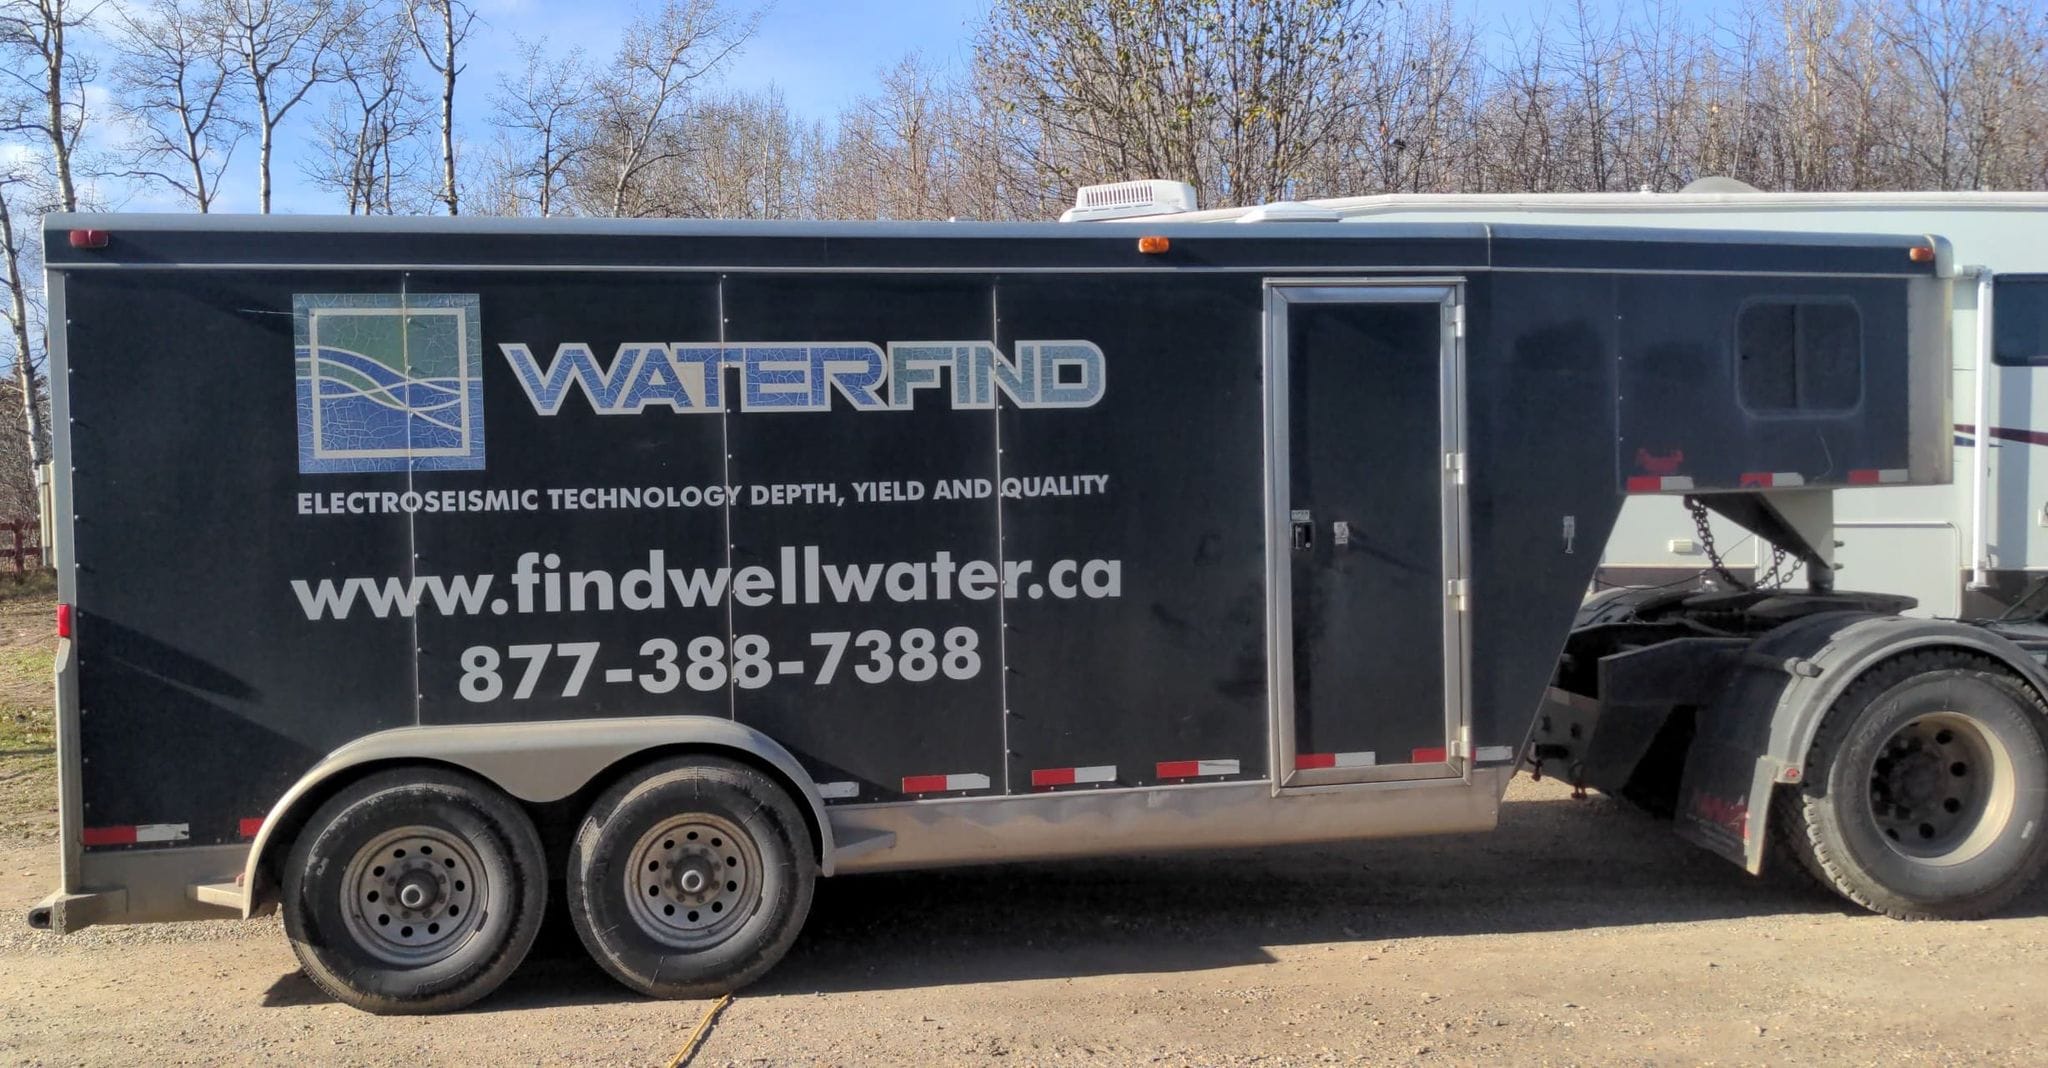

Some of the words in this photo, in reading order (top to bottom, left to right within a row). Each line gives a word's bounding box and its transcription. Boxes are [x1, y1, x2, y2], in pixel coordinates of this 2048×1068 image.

[498, 340, 1106, 416] WATERFIND
[298, 489, 538, 514] ELECTROSEISMIC
[547, 485, 742, 509] TECHNOLOGY
[751, 483, 845, 506] DEPTH,
[852, 481, 925, 502] YIELD
[933, 478, 993, 499] AND
[1001, 474, 1109, 498] QUALITY
[290, 545, 1121, 620] www.findwellwater.ca
[459, 626, 981, 702] 877-388-7388
